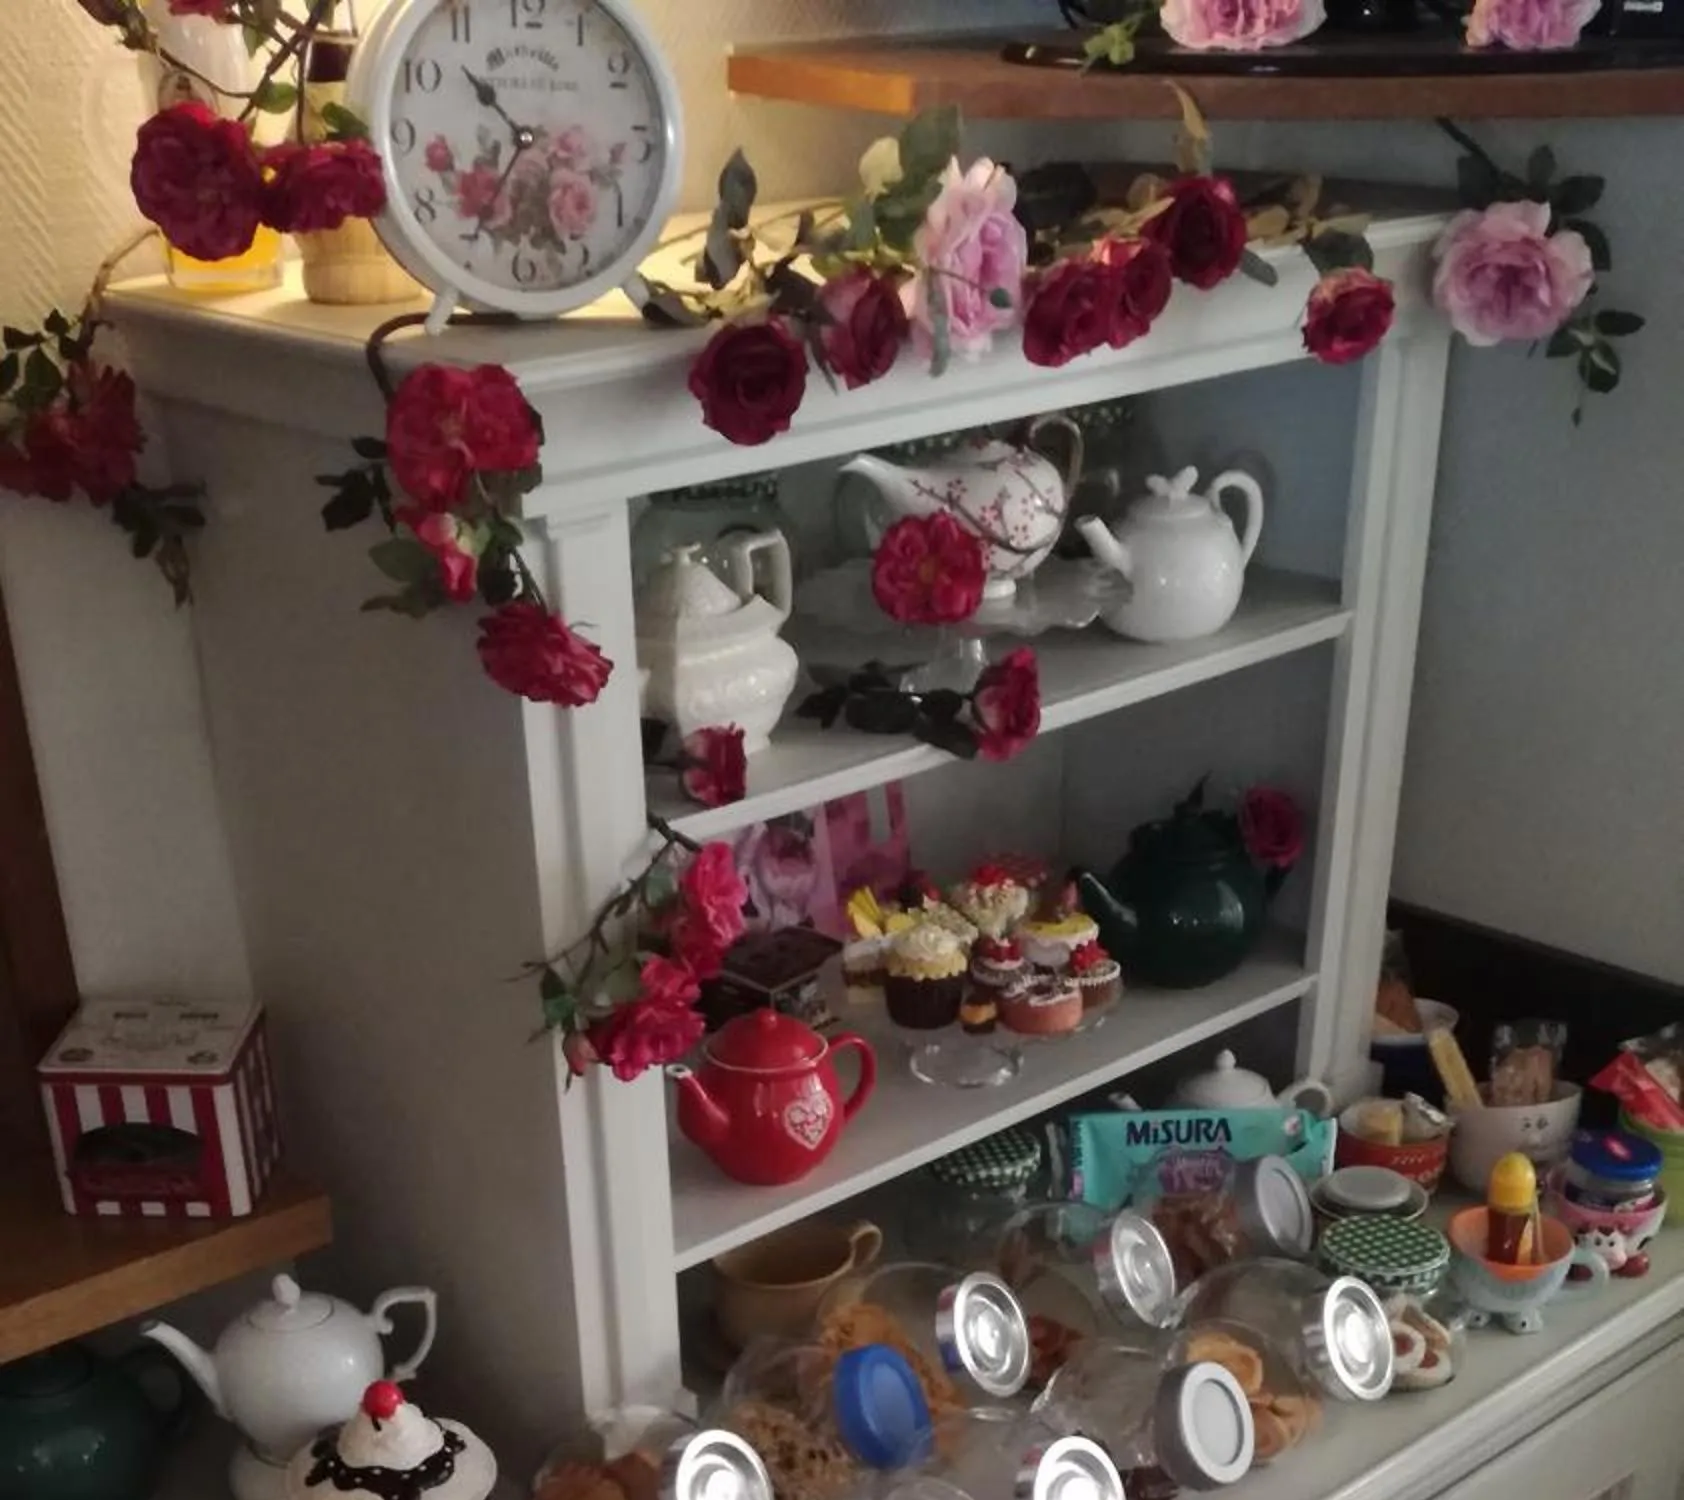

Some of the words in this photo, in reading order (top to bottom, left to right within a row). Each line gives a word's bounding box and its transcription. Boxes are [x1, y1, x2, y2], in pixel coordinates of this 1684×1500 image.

[450, 6, 471, 44] 11
[510, 0, 545, 30] 12
[576, 13, 584, 46] 1
[404, 59, 442, 93] 10
[391, 118, 416, 154] 9
[413, 186, 436, 225] 8
[511, 249, 537, 283] 6
